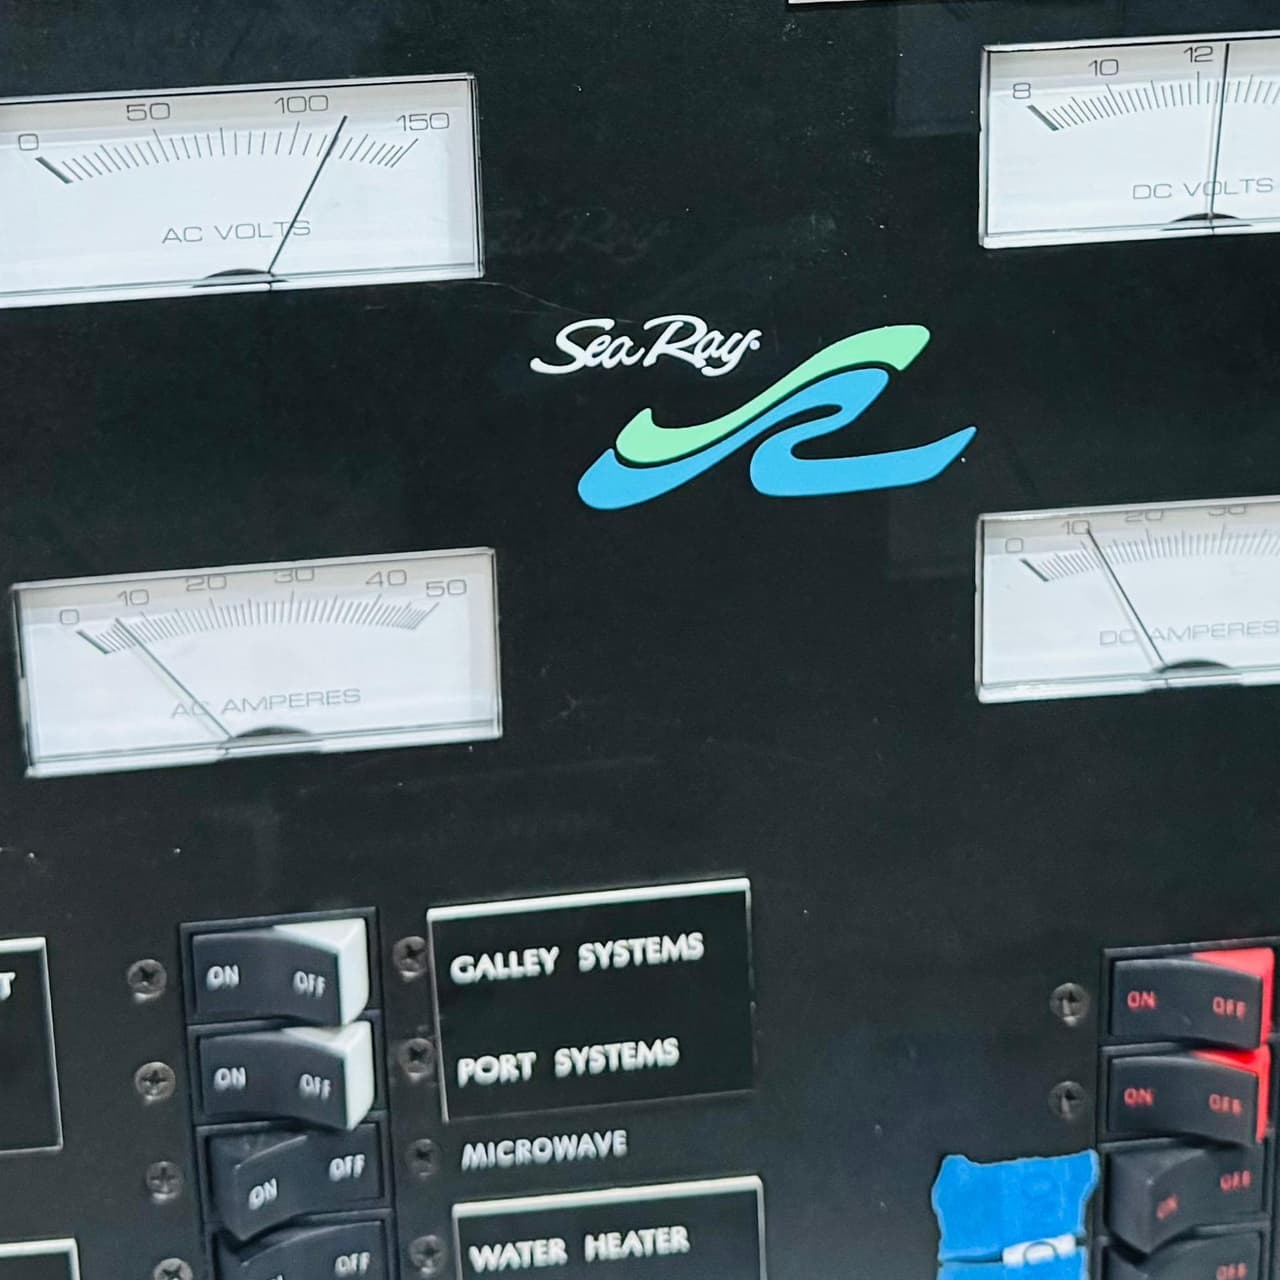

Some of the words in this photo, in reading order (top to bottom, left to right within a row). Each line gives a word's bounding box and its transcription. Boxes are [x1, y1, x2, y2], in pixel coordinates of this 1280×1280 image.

[1183, 46, 1213, 63] 12
[1088, 59, 1119, 76] 10
[1012, 82, 1031, 100] 8
[127, 103, 171, 122] 50
[274, 95, 329, 114] 100
[396, 112, 450, 131] 150
[1133, 184, 1172, 200] DC
[1183, 178, 1273, 198] VOLTS
[162, 226, 203, 243] AC
[215, 220, 311, 240] VOLTS
[530, 318, 644, 374] Sea
[643, 315, 762, 377] Ray
[186, 575, 228, 592] 20
[274, 568, 315, 583] 30
[366, 569, 407, 587] 40
[118, 589, 150, 606] 10
[427, 580, 467, 597] 50
[223, 688, 360, 713] AMPERES
[450, 946, 559, 985] GALLEY
[578, 932, 704, 973] SYSTEMS
[207, 966, 238, 988] ON
[294, 972, 325, 997] OFF
[458, 1051, 535, 1086] PORT
[555, 1038, 679, 1079] SYSTEMS
[215, 1067, 245, 1090] ON
[300, 1073, 331, 1099] OFF
[462, 1130, 627, 1170] MICROWAVE
[329, 1154, 364, 1181] OFF
[249, 1178, 277, 1207] ON
[470, 1238, 566, 1273] WATER
[585, 1225, 689, 1261] HEATER
[335, 1251, 370, 1277] OFF
